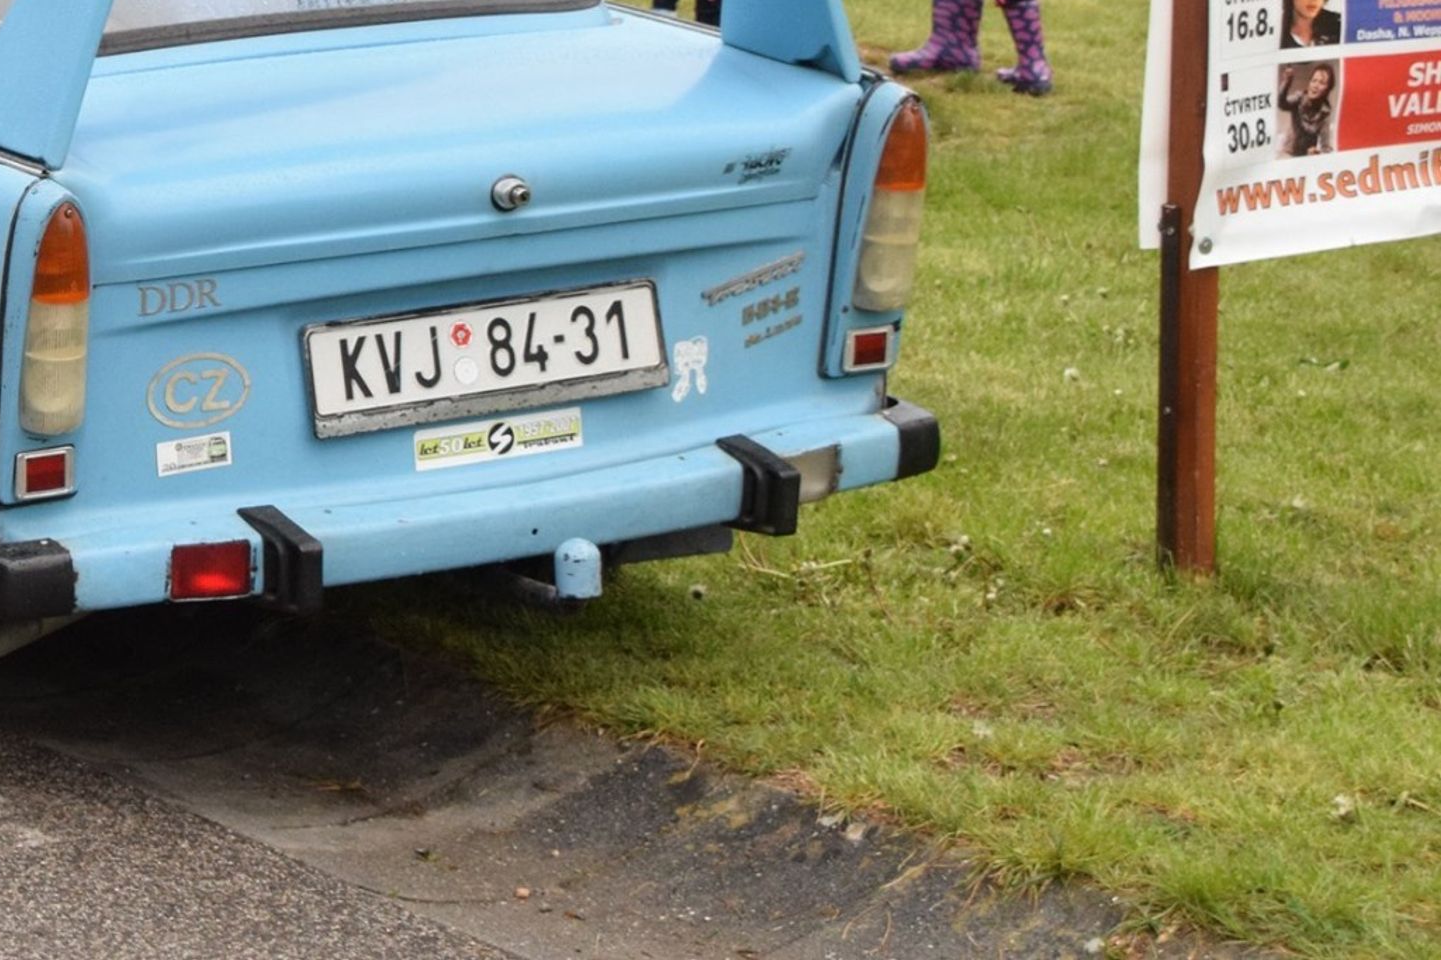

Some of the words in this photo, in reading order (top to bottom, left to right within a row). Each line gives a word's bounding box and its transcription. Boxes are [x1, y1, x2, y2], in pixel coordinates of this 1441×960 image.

[1227, 8, 1274, 41] 16.8.
[1224, 93, 1272, 117] ČTVRTEK
[1227, 118, 1271, 154] 30.8.
[137, 278, 222, 318] DDR
[338, 326, 443, 401] KVJ
[486, 299, 630, 378] 84-31
[164, 368, 231, 414] CZ
